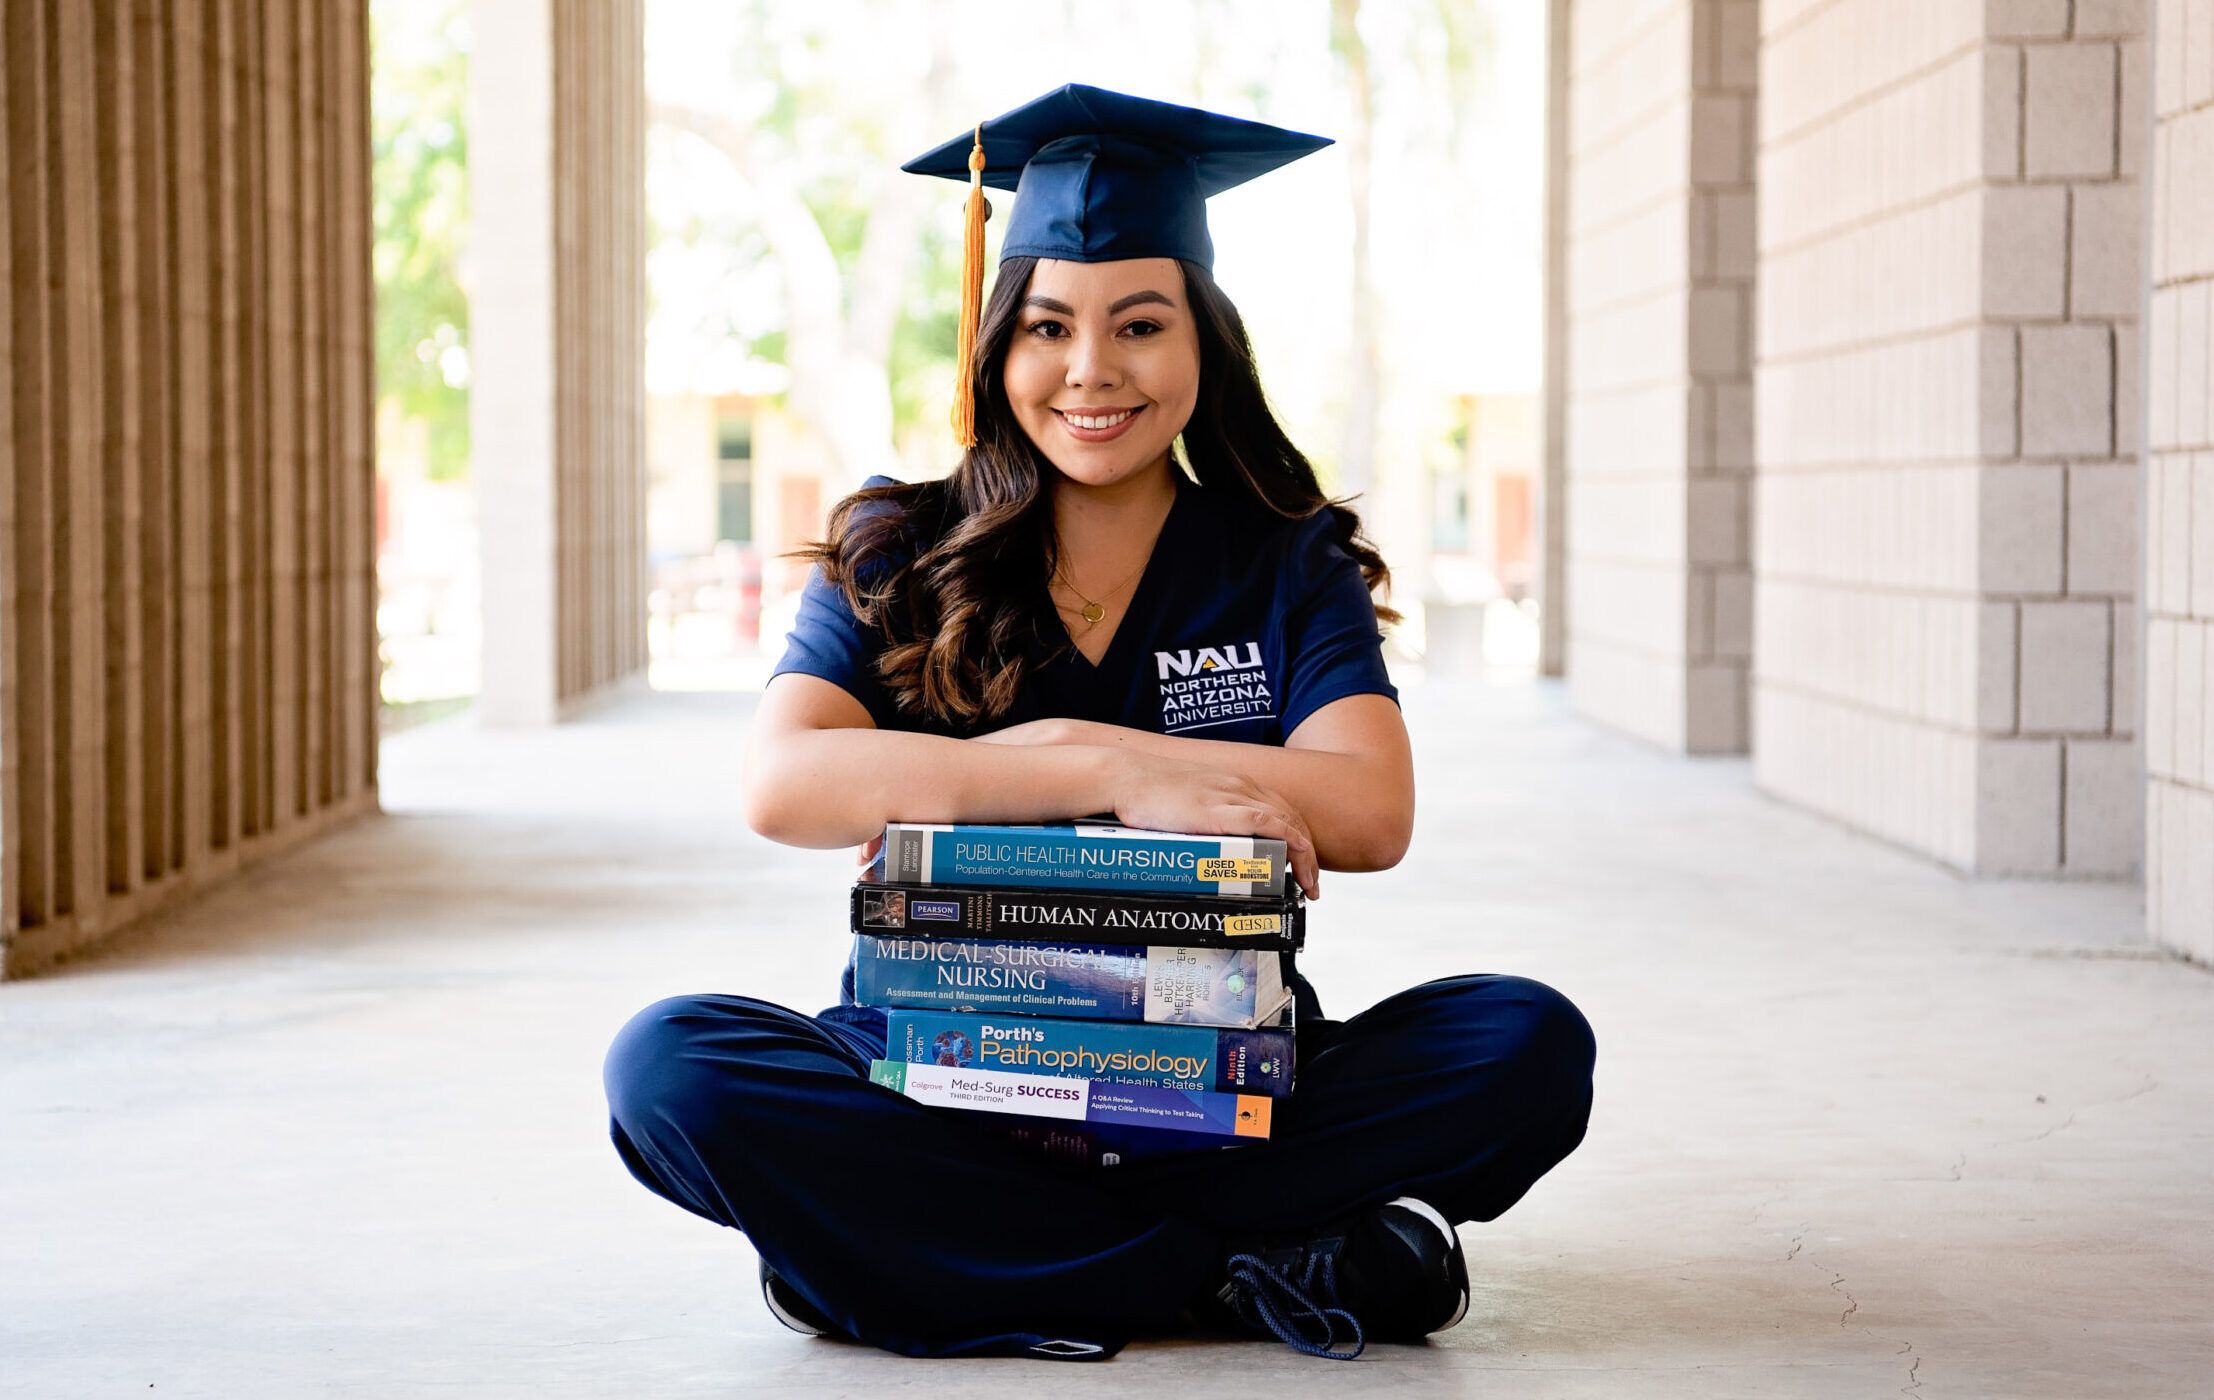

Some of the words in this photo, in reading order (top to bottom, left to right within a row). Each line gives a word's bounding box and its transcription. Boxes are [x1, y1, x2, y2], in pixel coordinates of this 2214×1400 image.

[1154, 642, 1263, 679] NAU
[1160, 670, 1267, 695] NORTHERN
[1163, 684, 1271, 712] ARIZONA
[1165, 700, 1272, 725] UNIVERSITY
[902, 840, 910, 872] Stanhope
[956, 843, 1011, 862] PUBLIC
[1016, 846, 1075, 864] HEALTH
[1080, 848, 1195, 869] NURSING
[1206, 860, 1235, 868] USED
[955, 864, 1051, 877] Population-Centered
[1054, 868, 1084, 878] Health
[1086, 869, 1109, 879] Care
[1112, 870, 1120, 879] in
[1123, 871, 1138, 880] the
[1140, 872, 1193, 885] Community
[1203, 869, 1238, 878] SAVES
[917, 905, 953, 914] PEARSON
[985, 891, 993, 932] TALLITSCH
[999, 905, 1097, 926] HUMAN
[1103, 908, 1229, 931] ANATOMY
[1233, 917, 1273, 931] USED
[876, 939, 1106, 970] MEDICAL-SURGICAL
[937, 965, 1046, 990] NURSING
[886, 987, 936, 998] Assessment
[938, 990, 954, 999] and
[956, 991, 1011, 1003] Management
[1012, 994, 1021, 1003] of
[1022, 994, 1055, 1004] Clinical
[1057, 995, 1098, 1007] Problems
[1131, 986, 1140, 1005] 10th
[981, 1025, 1045, 1042] Porth's
[916, 1036, 924, 1062] Porth
[980, 1041, 1208, 1079] Pathophysiology
[1227, 1050, 1236, 1080] Ninth
[1236, 1046, 1246, 1085] Edition
[1272, 1057, 1280, 1078] LWW
[911, 1081, 943, 1091] Colgrove
[951, 1078, 1013, 1097] Med-Surg
[1017, 1085, 1080, 1101] SUCCESS
[1162, 1078, 1204, 1091] States
[950, 1092, 972, 1100] THIRD
[973, 1095, 1003, 1103] EDITION
[1112, 1096, 1134, 1104] Review
[1091, 1102, 1117, 1111] Applying
[1139, 1107, 1164, 1116] Thinking
[1185, 1111, 1204, 1119] Taking
